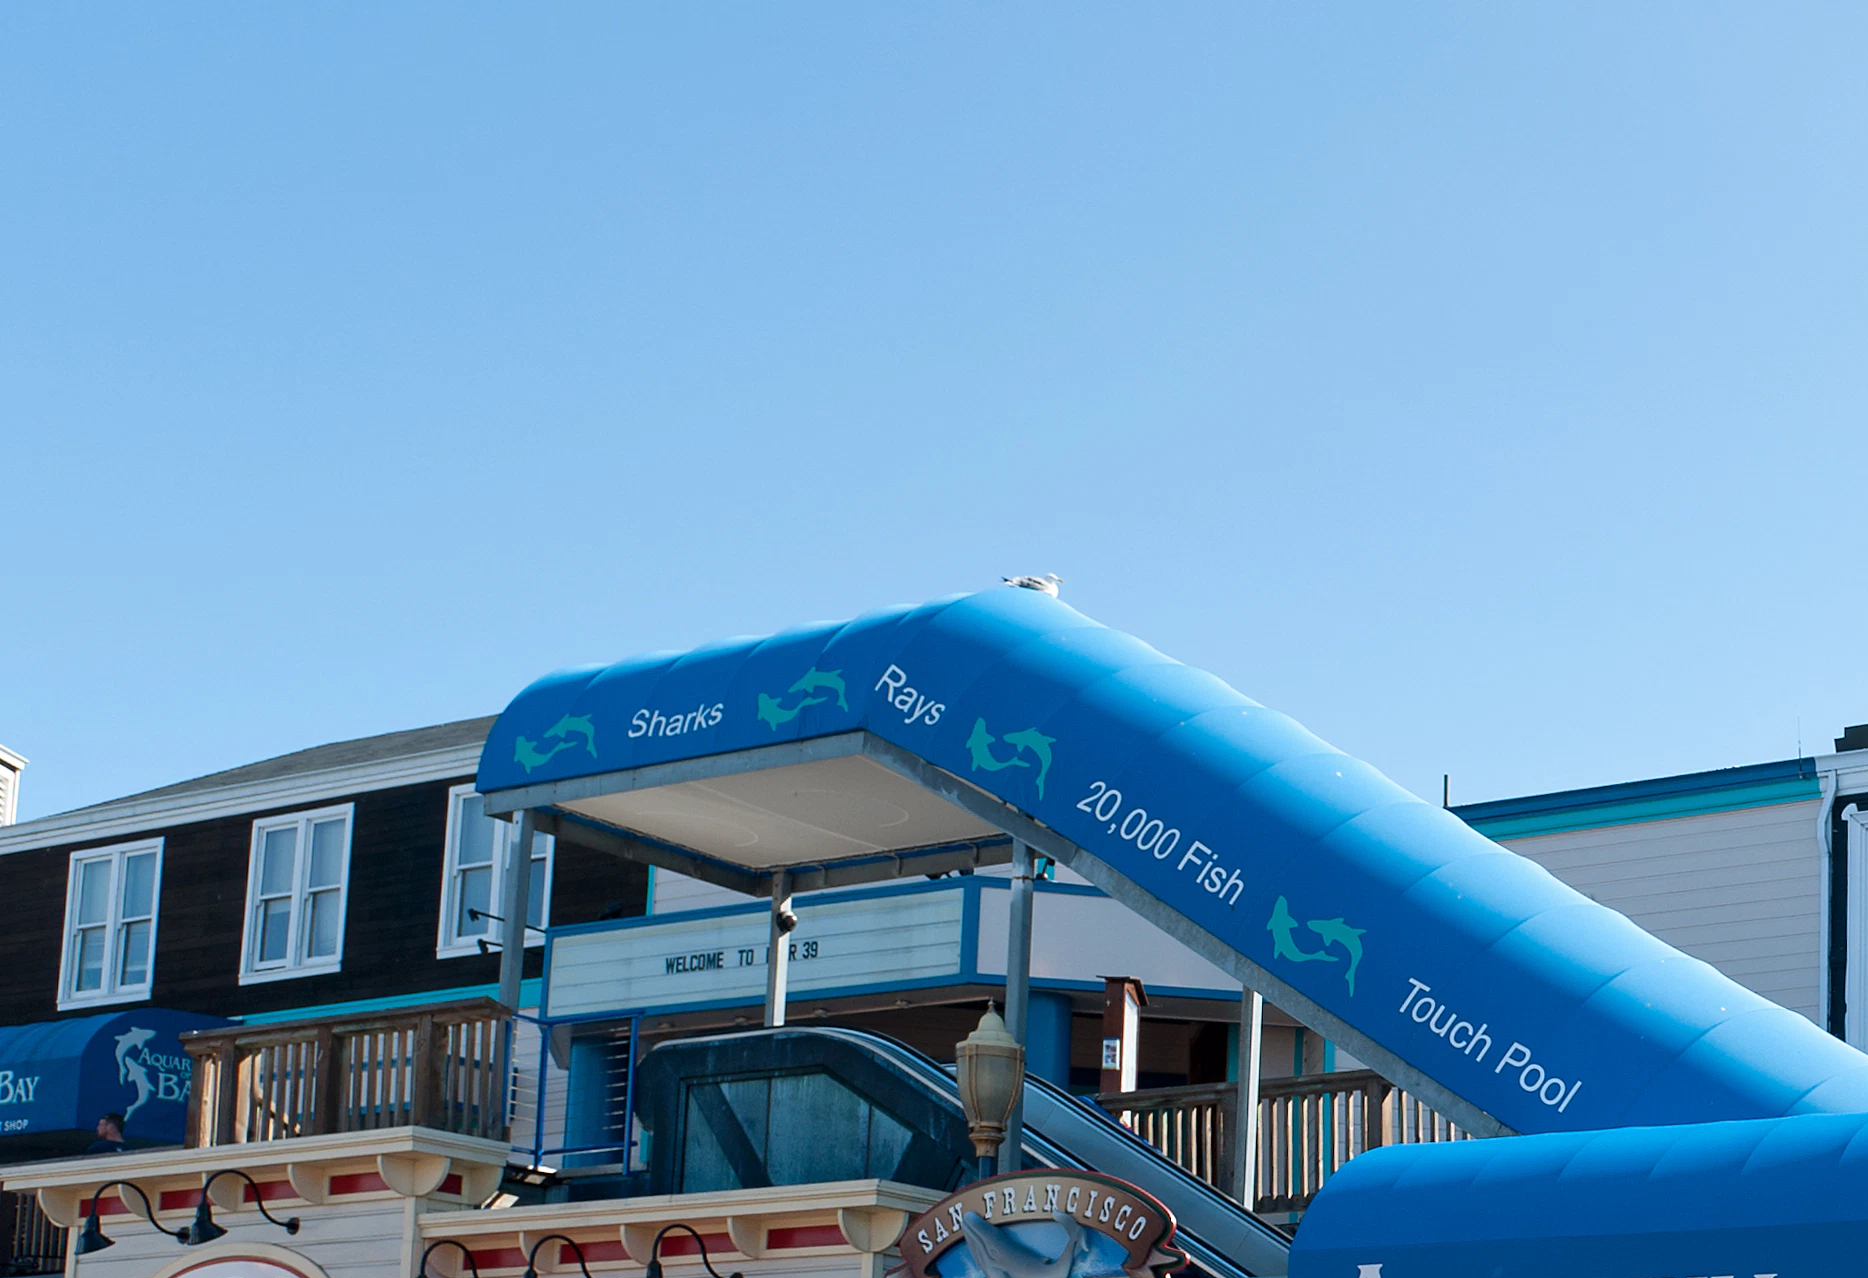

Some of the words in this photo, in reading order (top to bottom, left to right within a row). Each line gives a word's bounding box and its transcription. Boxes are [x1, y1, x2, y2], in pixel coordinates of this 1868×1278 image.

[627, 702, 724, 738] Sharks
[873, 662, 948, 731] Rays
[1076, 779, 1182, 862] 20,000
[1176, 840, 1245, 906] Fish
[665, 951, 724, 975] WELCOME
[738, 950, 754, 967] TO
[802, 941, 819, 959] 39
[1398, 977, 1493, 1065] Touch
[1493, 1040, 1583, 1115] Pool
[4, 1119, 29, 1132] SHOP
[917, 1203, 964, 1253] SAN
[983, 1184, 1148, 1241] FRANCISCO
